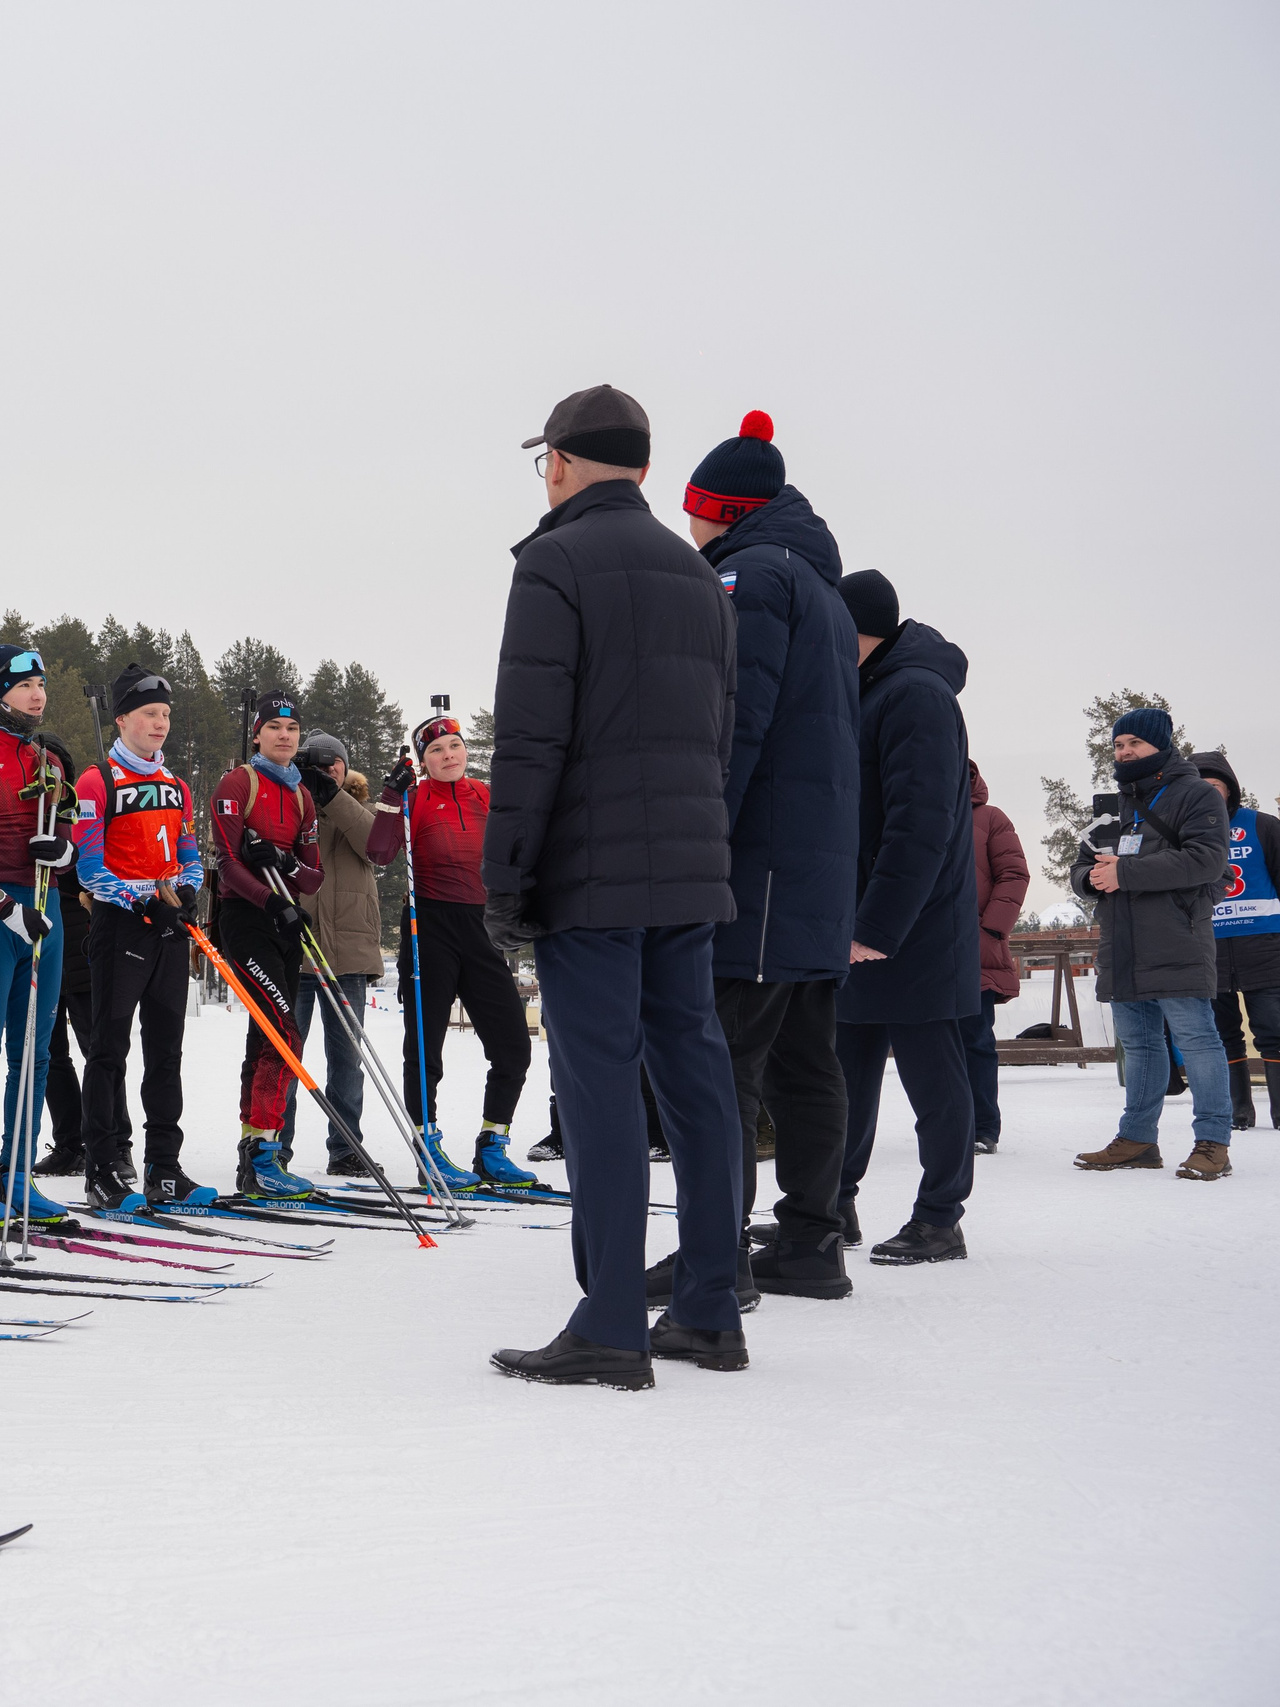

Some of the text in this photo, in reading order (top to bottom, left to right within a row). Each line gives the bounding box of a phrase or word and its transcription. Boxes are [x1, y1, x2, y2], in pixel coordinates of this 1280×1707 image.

[156, 824, 171, 862] 1
[246, 957, 290, 1013] УДМУРТИЯ
[256, 1172, 300, 1192] SPINE
[169, 1206, 209, 1215] salomon
[266, 1201, 306, 1209] salomon
[105, 1212, 134, 1222] salomon
